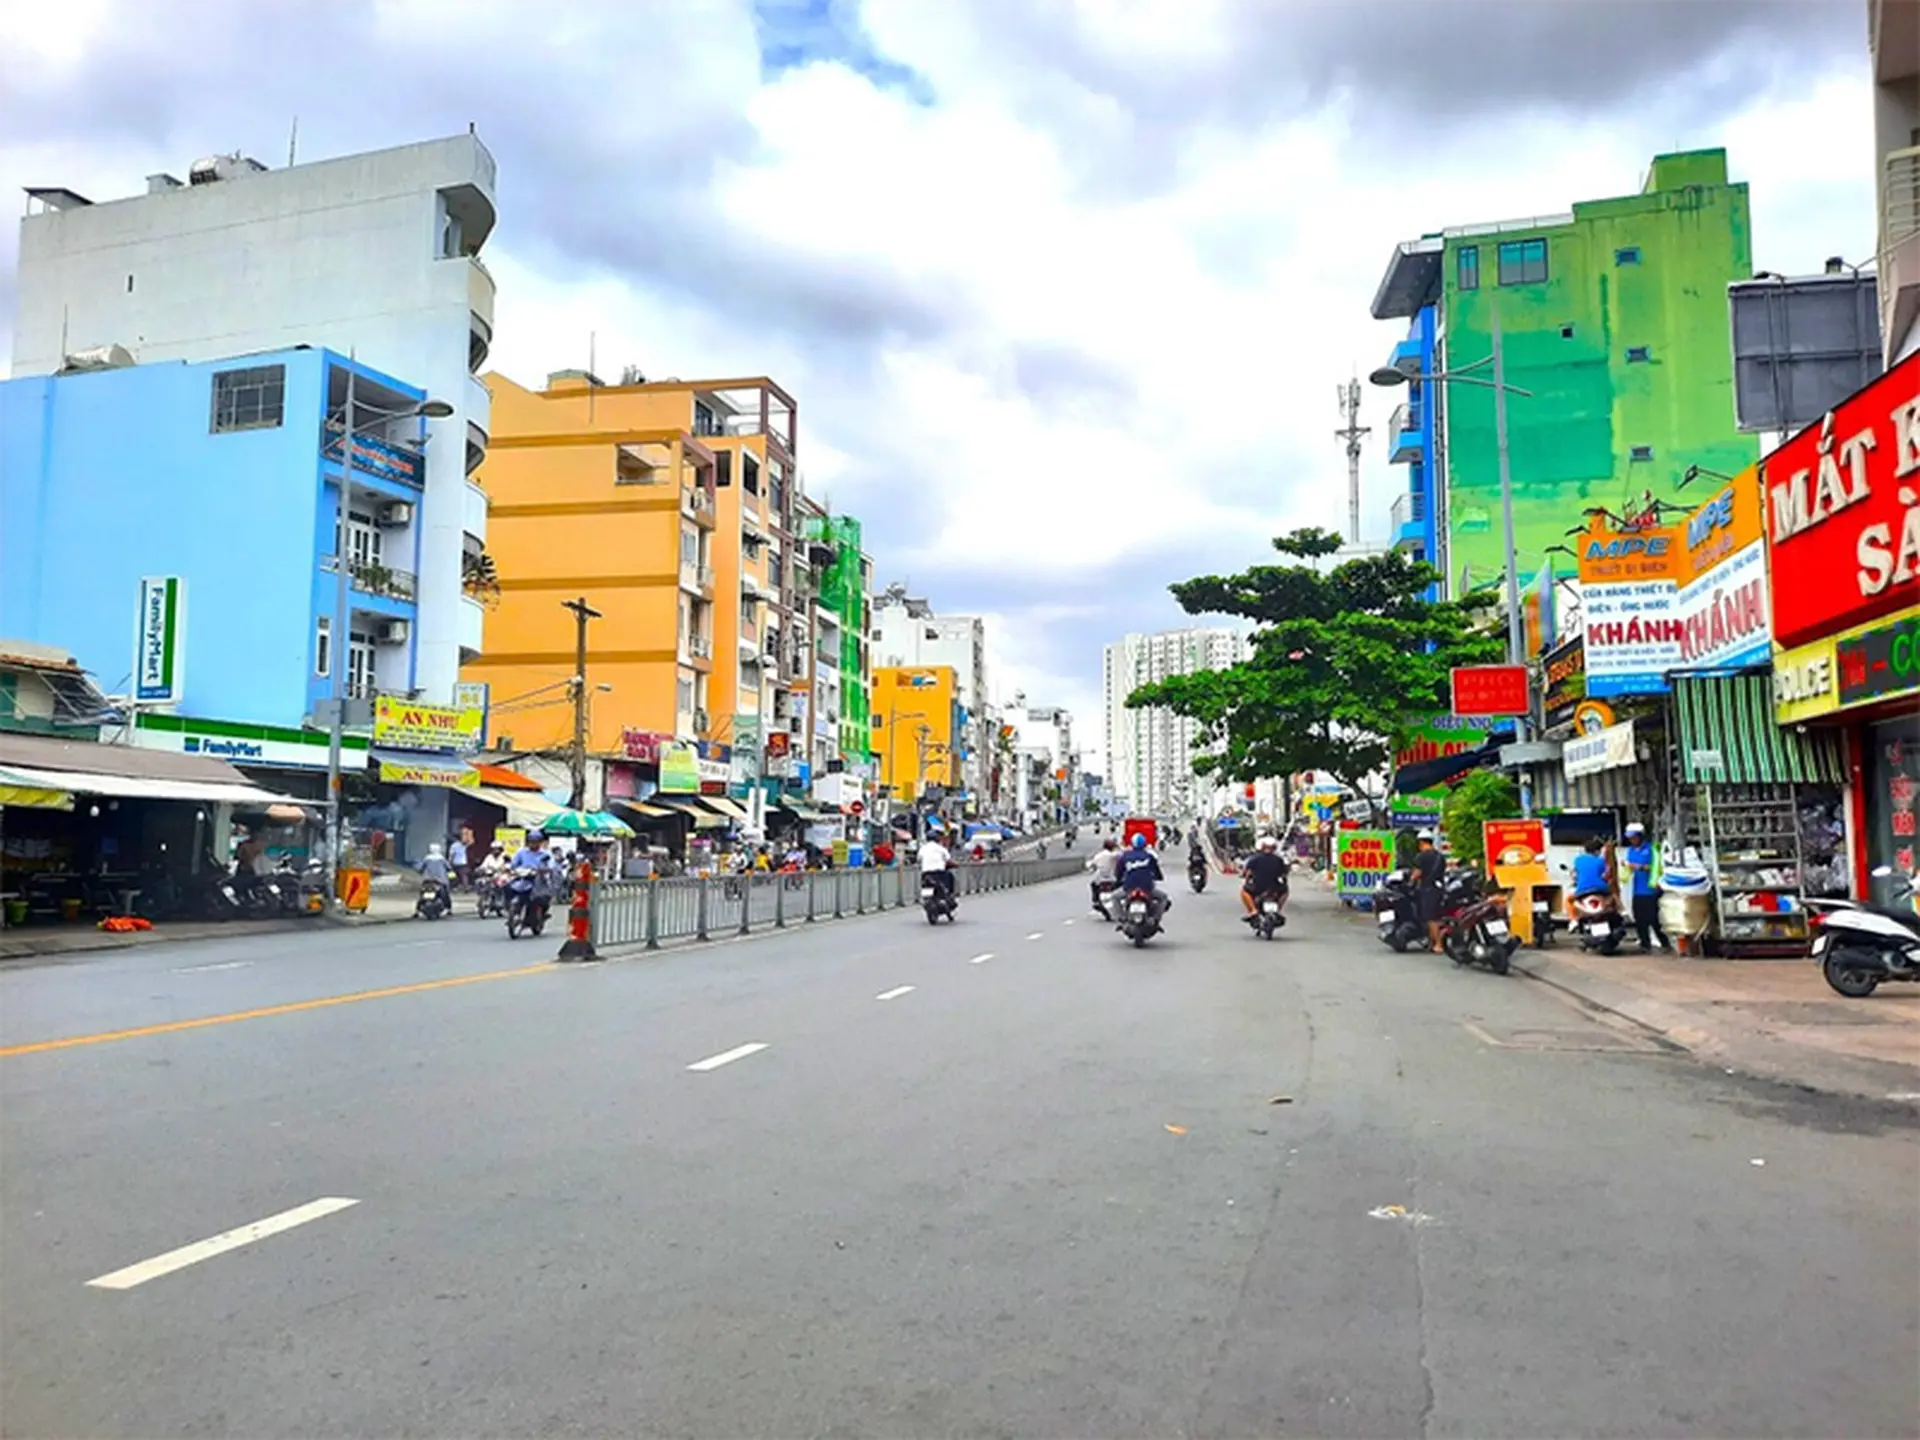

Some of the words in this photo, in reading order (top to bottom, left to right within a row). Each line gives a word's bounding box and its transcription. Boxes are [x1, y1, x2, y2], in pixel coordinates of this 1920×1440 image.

[1771, 411, 1877, 544] MẮT
[1688, 488, 1735, 552] MPE
[1585, 537, 1671, 560] MPE
[1587, 615, 1683, 645] KHÁNH
[1680, 578, 1765, 663] KHÁNH
[147, 587, 164, 681] FamilyMart
[401, 711, 423, 725] AN
[203, 738, 262, 757] FamilyMart
[402, 770, 423, 782] AN
[1341, 851, 1391, 869] CHAY
